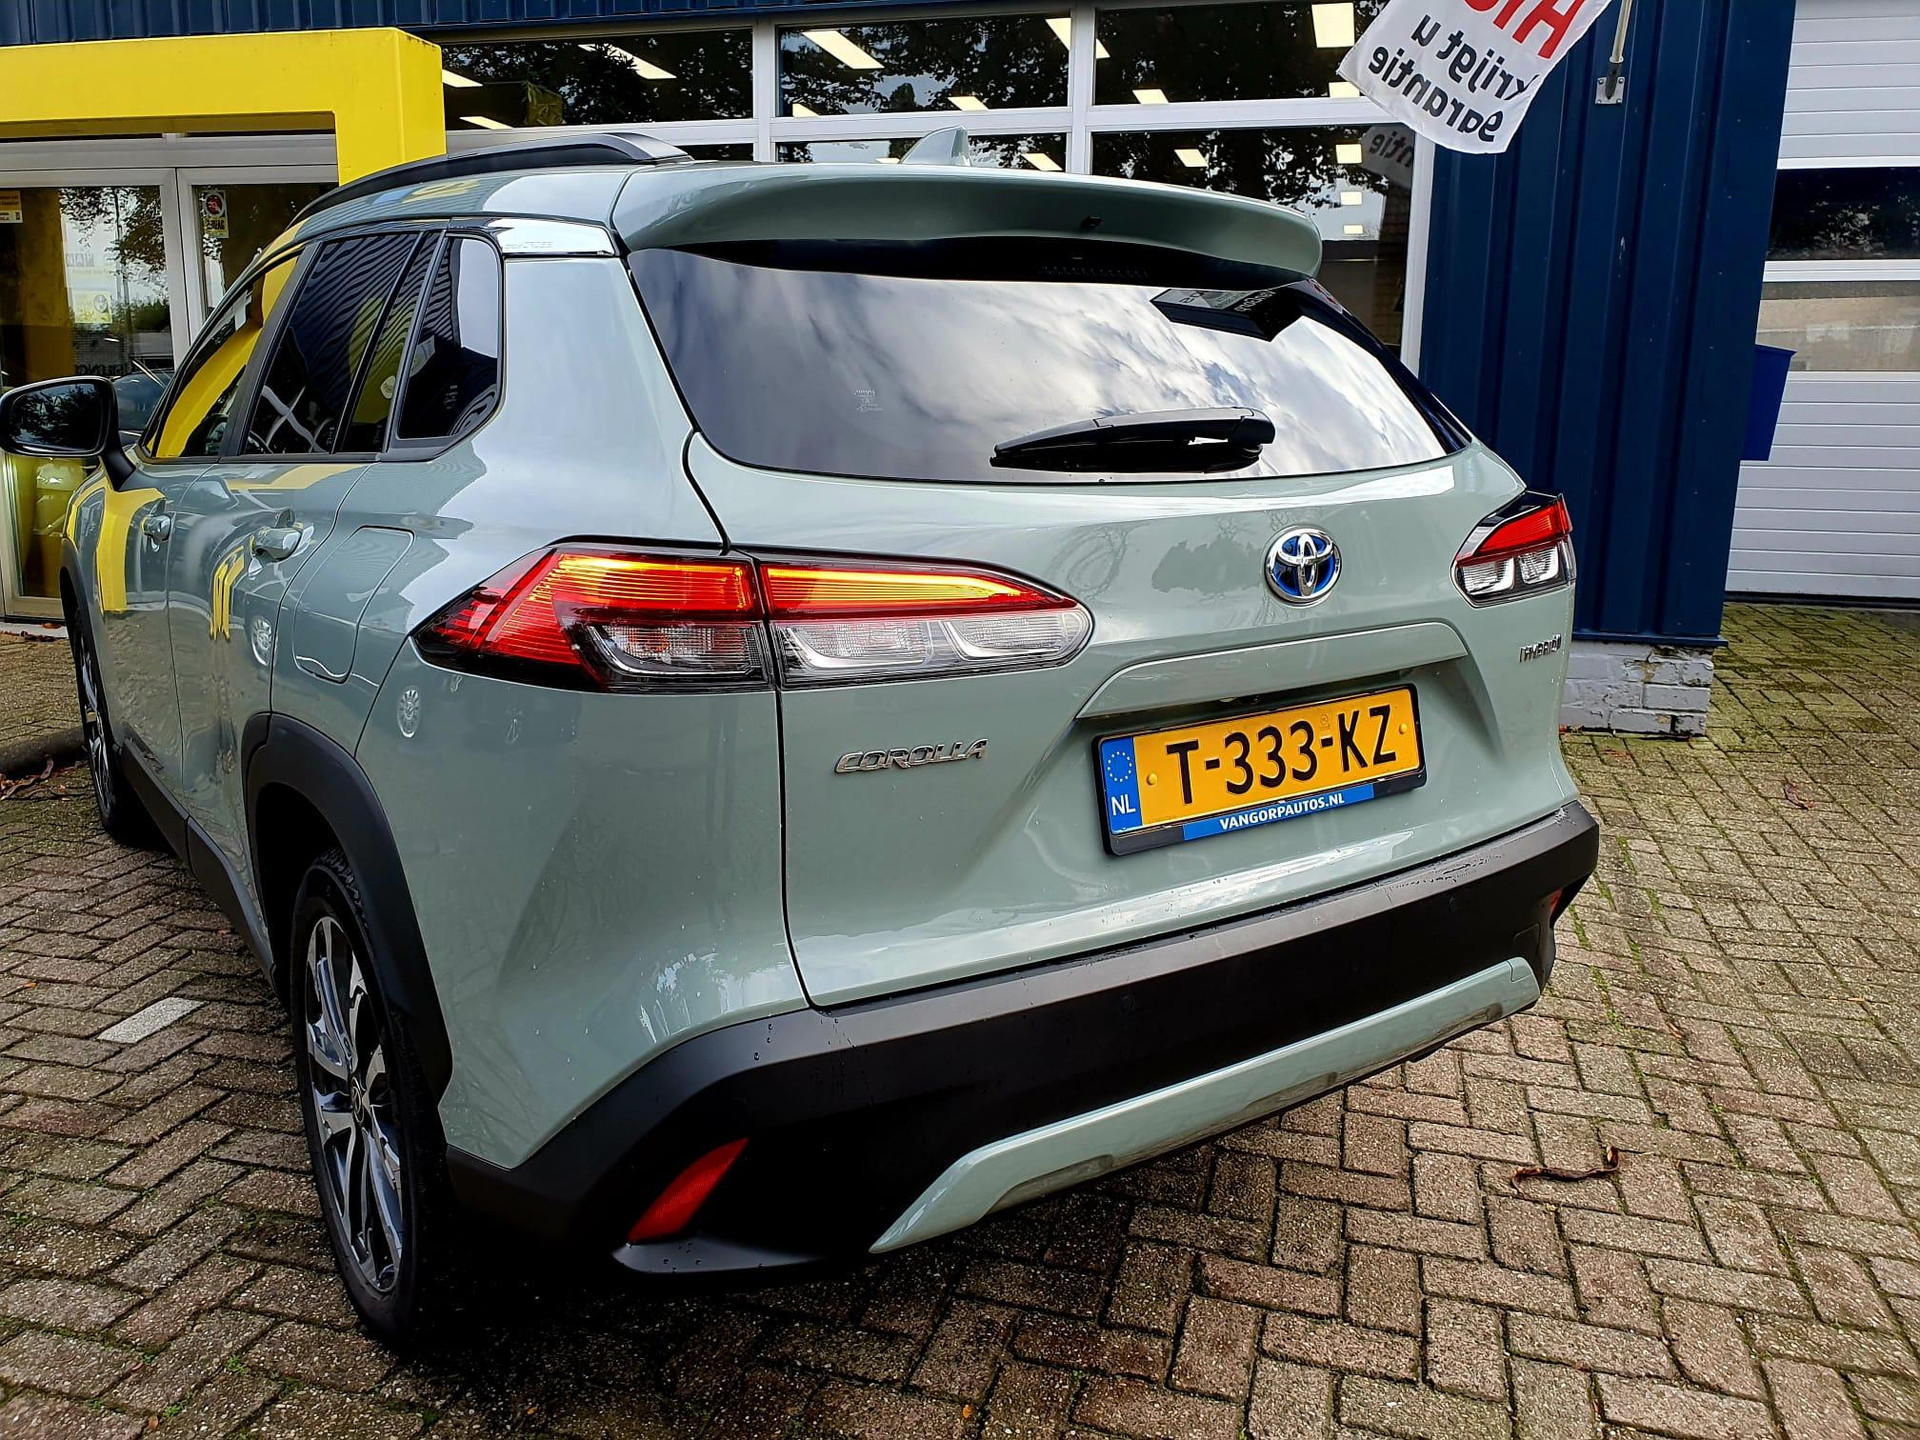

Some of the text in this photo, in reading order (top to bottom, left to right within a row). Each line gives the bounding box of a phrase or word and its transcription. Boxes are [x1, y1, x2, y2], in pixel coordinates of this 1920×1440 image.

[834, 738, 989, 774] COROLLA
[1166, 704, 1398, 805] T-333-KZ
[1111, 796, 1136, 816] NL
[1219, 793, 1346, 831] VANGORPAUTOS.NL
